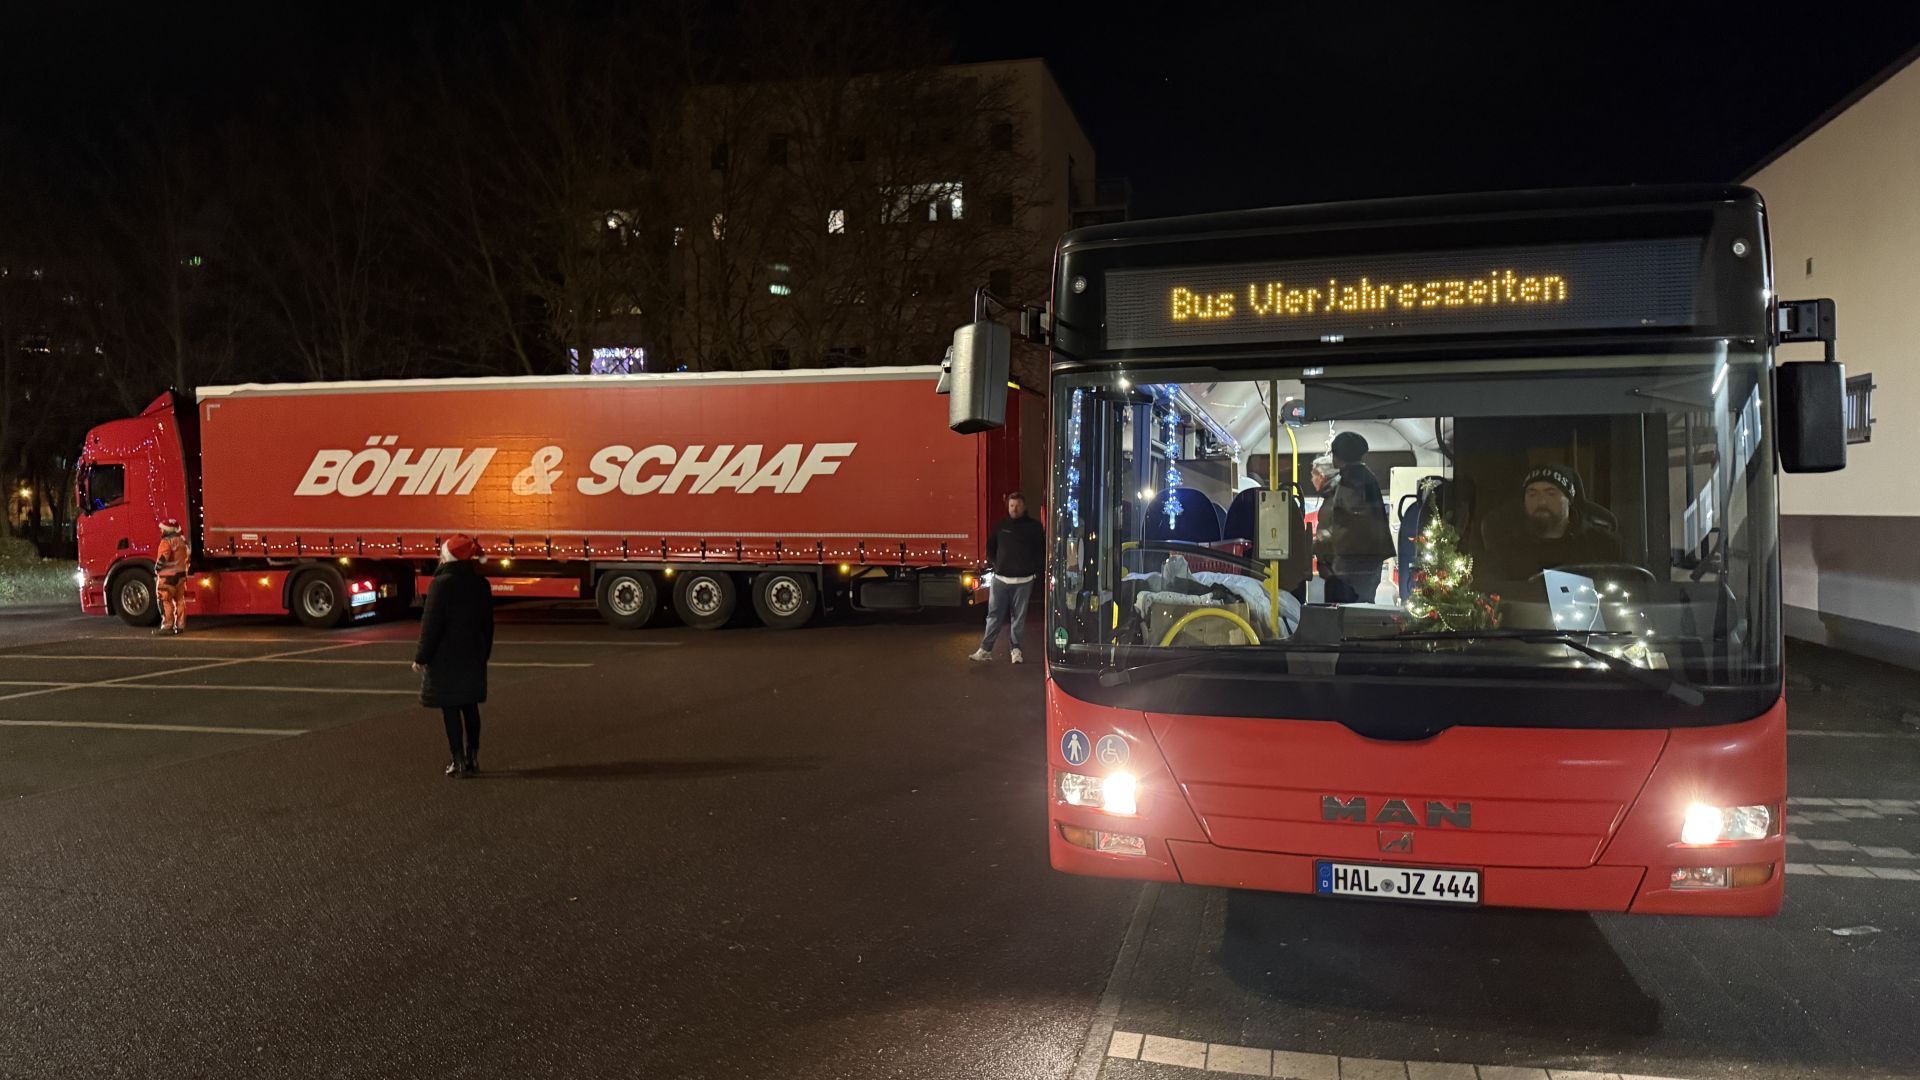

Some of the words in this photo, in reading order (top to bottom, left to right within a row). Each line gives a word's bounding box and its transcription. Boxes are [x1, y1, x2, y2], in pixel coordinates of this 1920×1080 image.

[1171, 287, 1235, 320] Bus
[1249, 268, 1567, 316] Vierjahreszeiten
[293, 435, 498, 497] BÖHM
[511, 445, 563, 496] &
[576, 442, 858, 496] SCHAAF
[1322, 795, 1472, 829] MAN
[1334, 867, 1378, 893] HAL
[1396, 871, 1426, 896] JZ
[1432, 874, 1475, 899] 444
